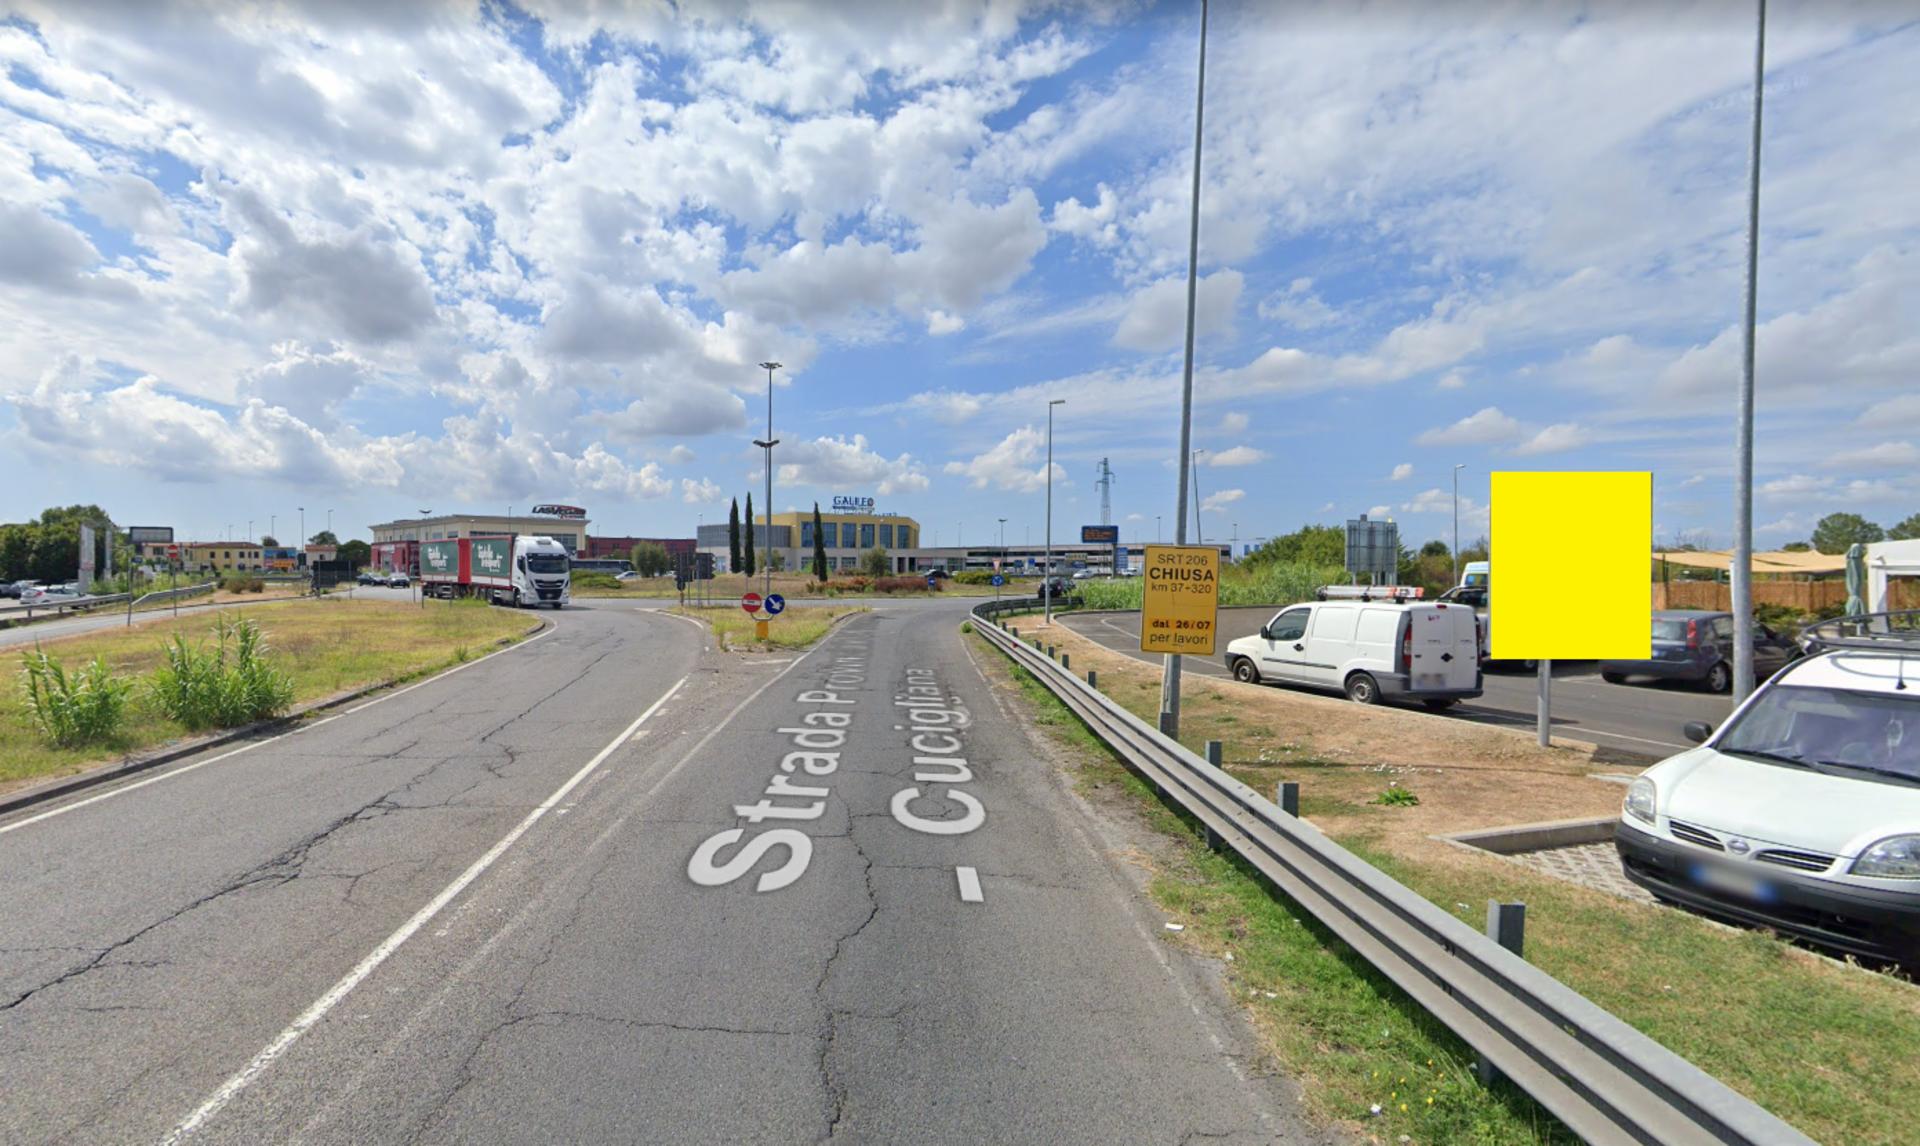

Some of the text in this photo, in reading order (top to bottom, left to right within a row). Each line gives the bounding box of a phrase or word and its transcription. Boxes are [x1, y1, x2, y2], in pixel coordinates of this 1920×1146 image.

[1157, 553, 1208, 566] SRT 206
[1149, 567, 1214, 581] CHIUSA
[1151, 582, 1168, 592] km
[1152, 619, 1211, 630] dal 26/07
[1150, 633, 1208, 645] per lavori
